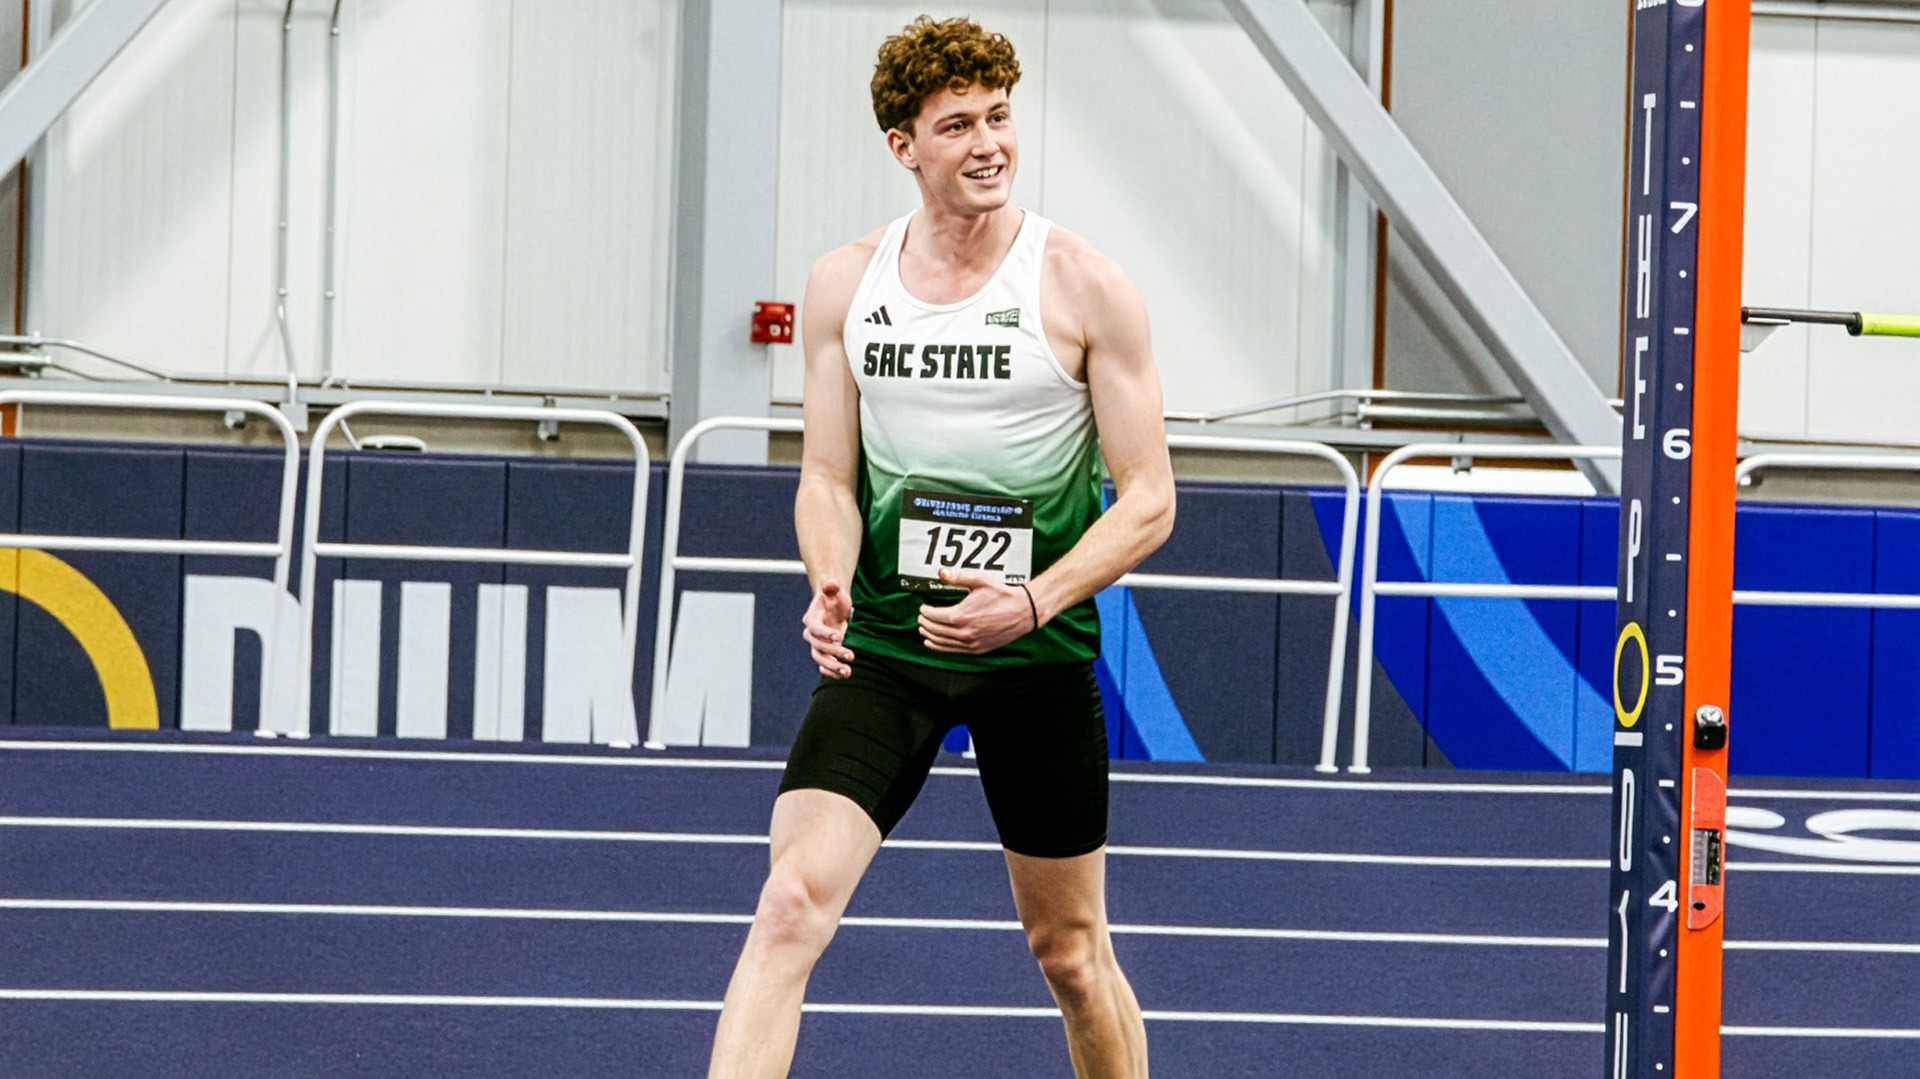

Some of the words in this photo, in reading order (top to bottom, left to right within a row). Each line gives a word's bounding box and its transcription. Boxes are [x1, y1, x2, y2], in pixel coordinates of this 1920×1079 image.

[1670, 201, 1698, 234] 7
[1633, 93, 1656, 440] THE
[863, 342, 915, 378] SAC
[919, 344, 1012, 380] STATE
[1662, 428, 1692, 460] 6
[924, 525, 1012, 571] 1522
[1655, 654, 1684, 686] 5
[1648, 880, 1679, 913] 4
